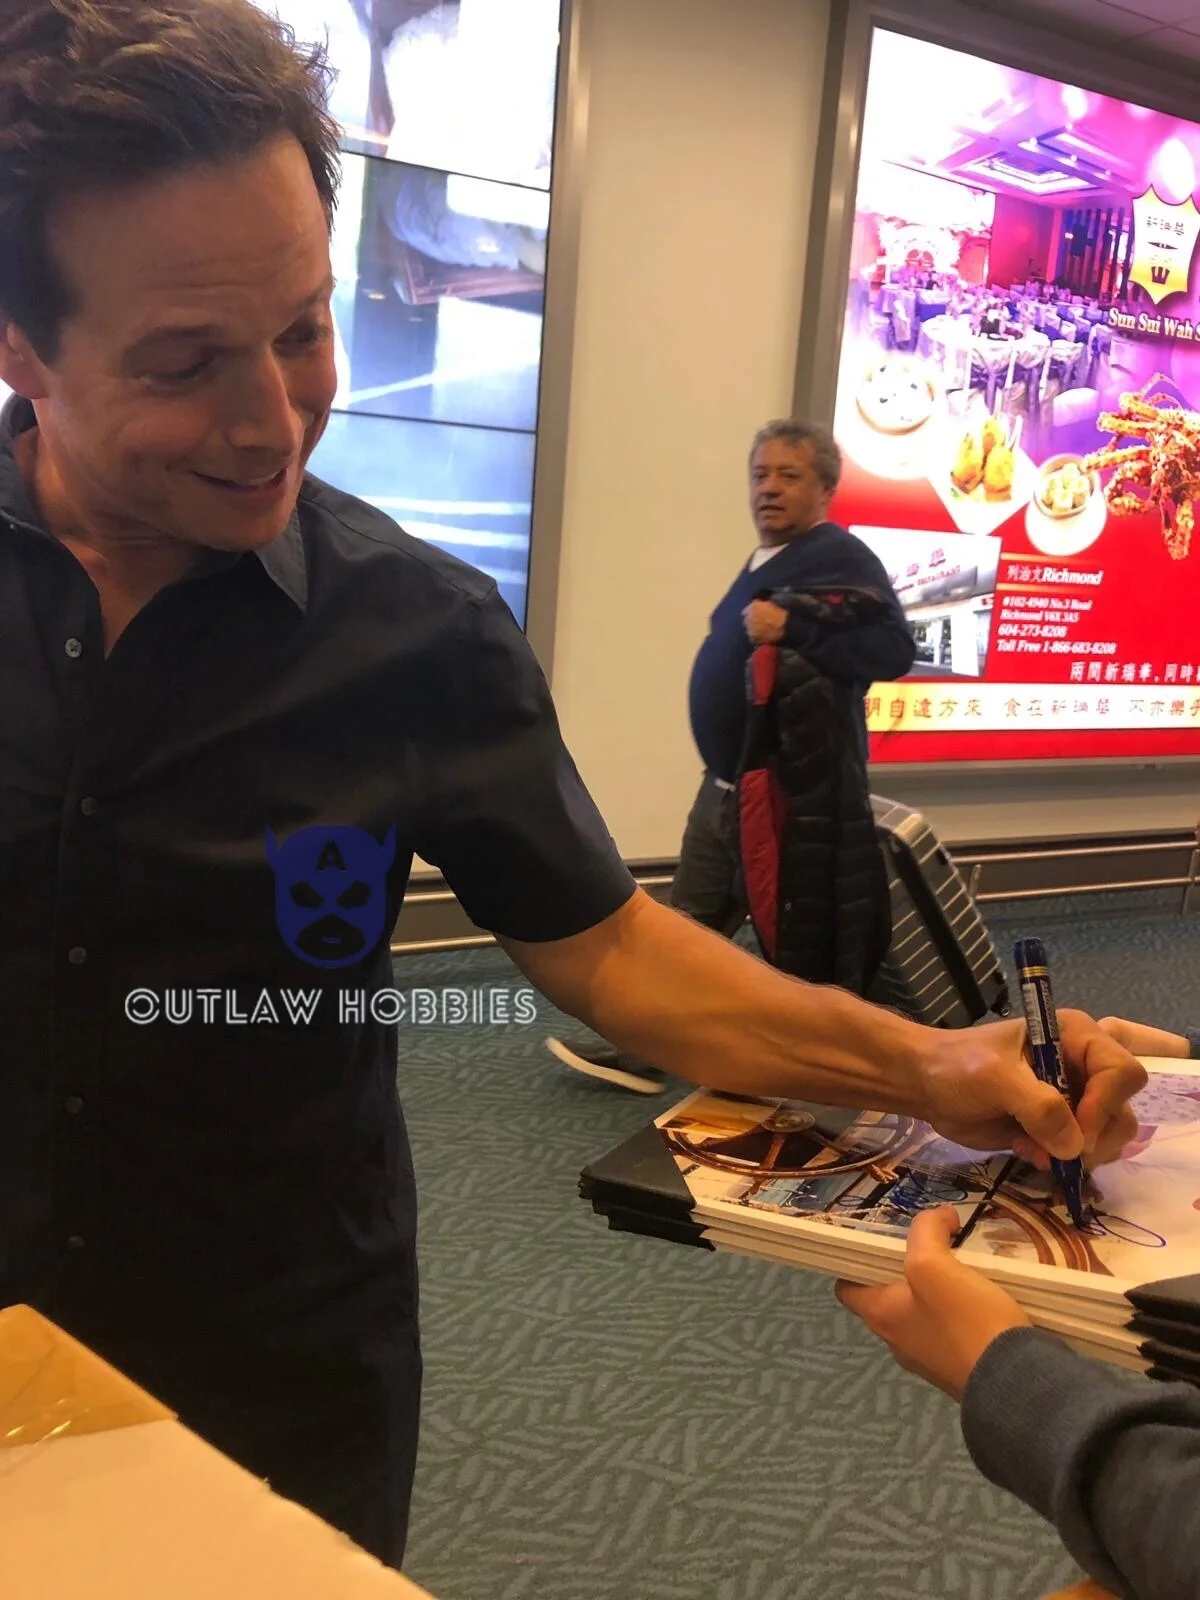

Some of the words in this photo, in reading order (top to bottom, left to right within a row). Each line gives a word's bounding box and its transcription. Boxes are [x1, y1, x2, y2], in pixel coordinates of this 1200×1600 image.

[1108, 307, 1136, 330] Sun
[1137, 313, 1162, 333] Sui
[1163, 317, 1194, 340] Wah
[1071, 599, 1093, 611] Road
[1000, 609, 1043, 621] Richmond
[997, 639, 1016, 652] Toll
[1017, 640, 1041, 653] Free
